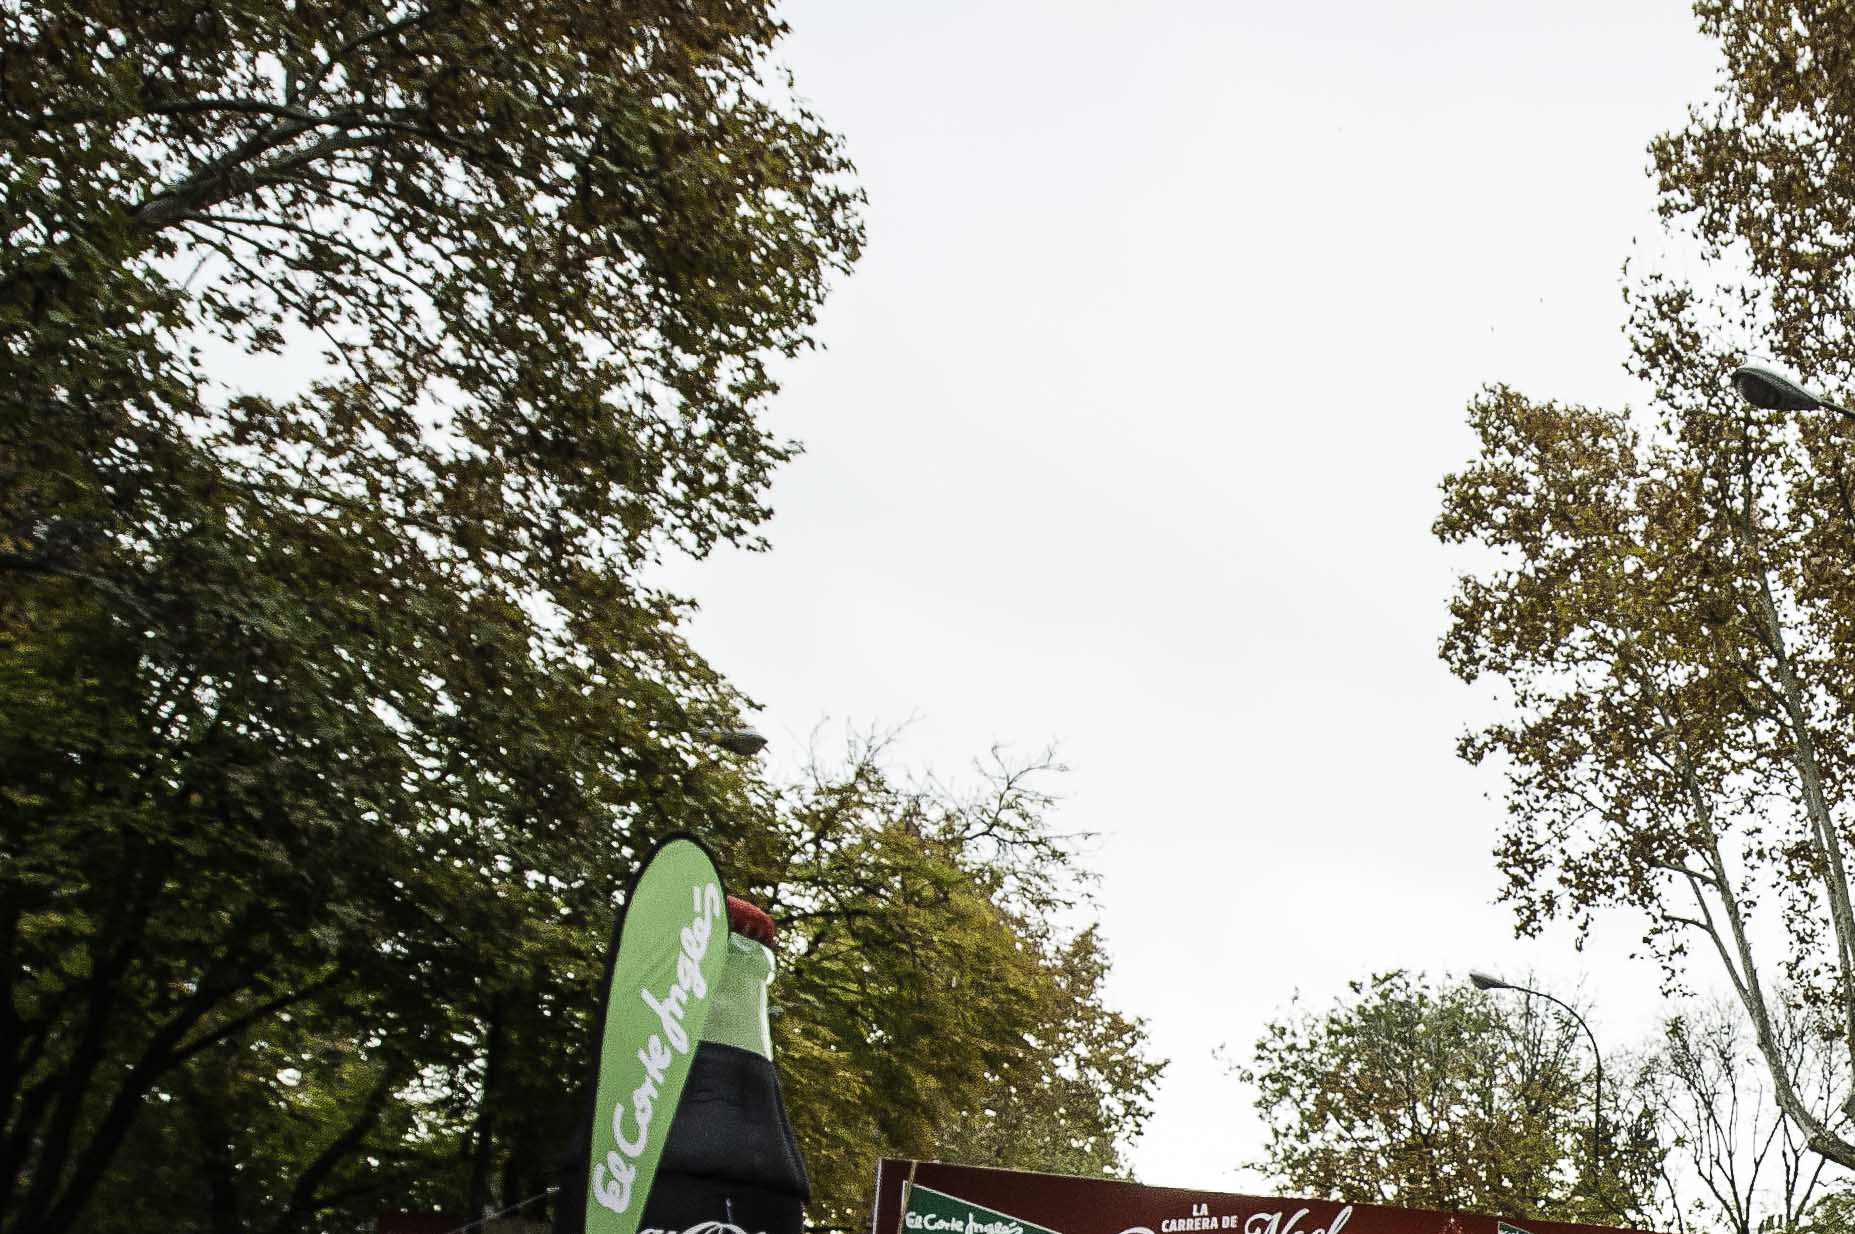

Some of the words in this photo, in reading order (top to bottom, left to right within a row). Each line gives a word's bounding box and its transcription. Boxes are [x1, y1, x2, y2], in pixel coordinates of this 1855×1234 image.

[640, 881, 721, 1054] Inglés
[612, 1032, 672, 1160] Corte
[594, 1145, 637, 1213] El
[905, 1211, 923, 1229] El
[922, 1213, 964, 1233] Corte
[1161, 1215, 1218, 1233] CARRERA
[1221, 1215, 1238, 1229] DE
[1192, 1203, 1208, 1217] LA
